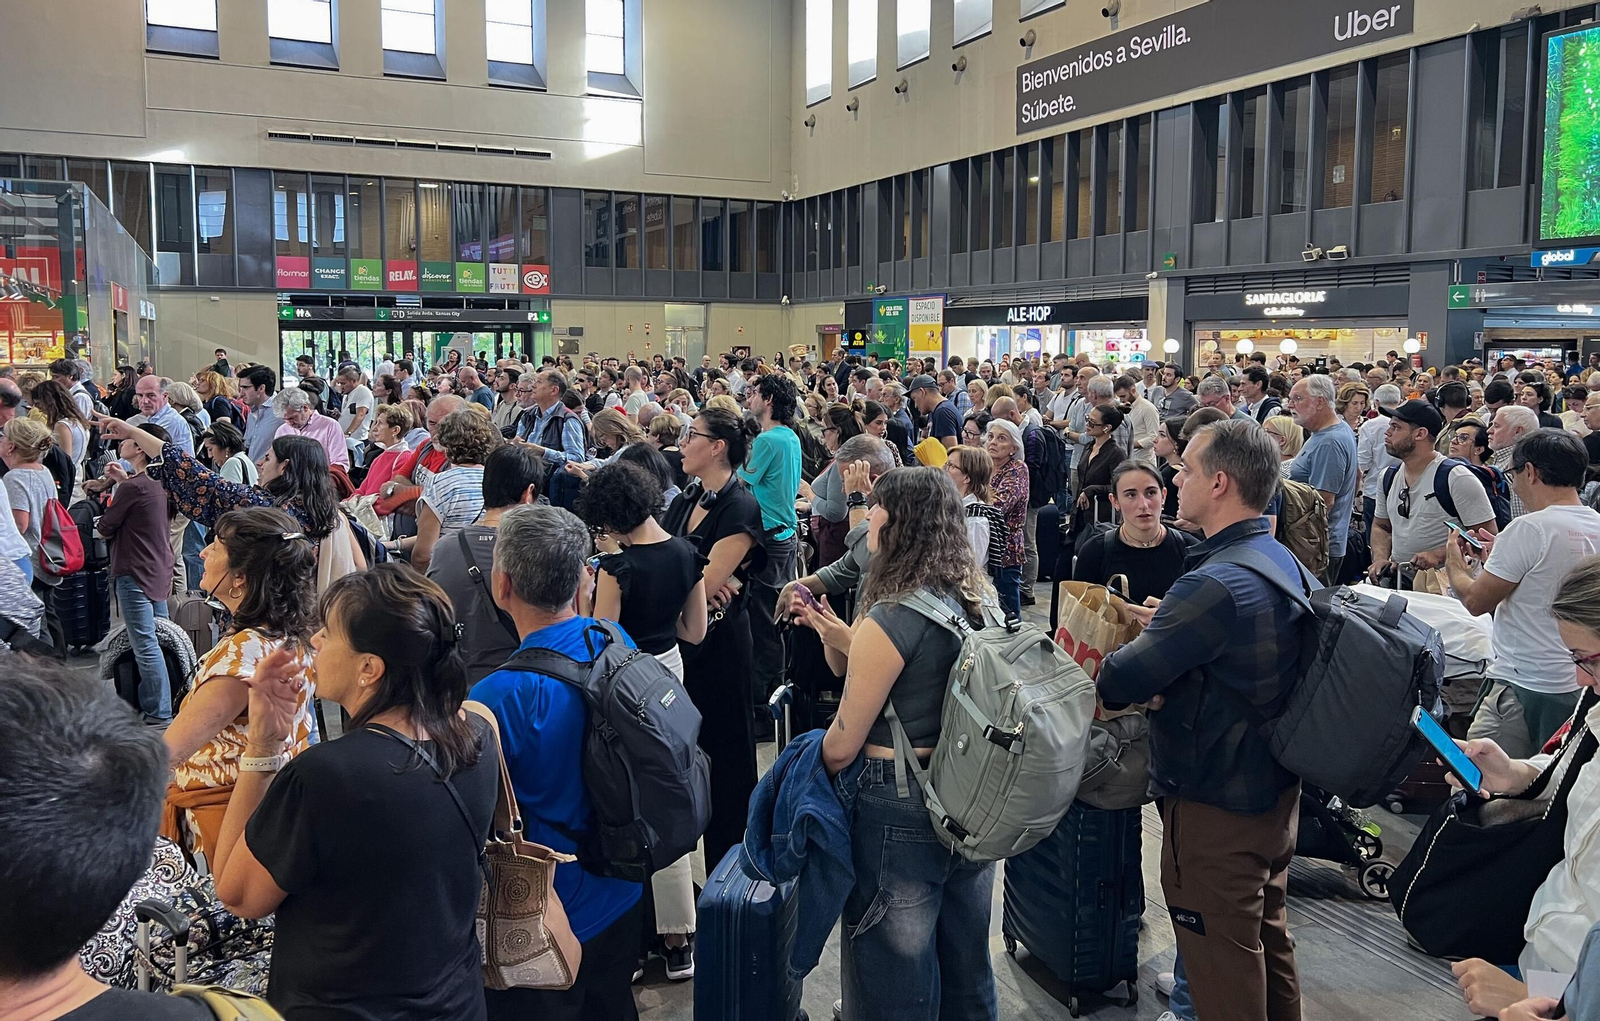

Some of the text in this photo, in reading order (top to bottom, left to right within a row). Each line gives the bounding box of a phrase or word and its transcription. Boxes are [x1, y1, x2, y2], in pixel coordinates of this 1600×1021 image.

[1334, 5, 1400, 41] Uber
[1022, 24, 1191, 93] Bienvenidos a Sevilla.
[1022, 93, 1077, 124] Súbete.
[1541, 249, 1575, 266] global
[277, 268, 309, 277] flormar
[421, 267, 451, 279] discover
[491, 267, 516, 275] TUTTI
[353, 274, 380, 282] tiendas
[1245, 291, 1327, 305] SANTAGLORIA
[915, 301, 935, 311] ESPACIO
[527, 312, 539, 321] P1
[911, 313, 940, 323] DISPONIBLE
[1007, 306, 1051, 322] ALE-HOP
